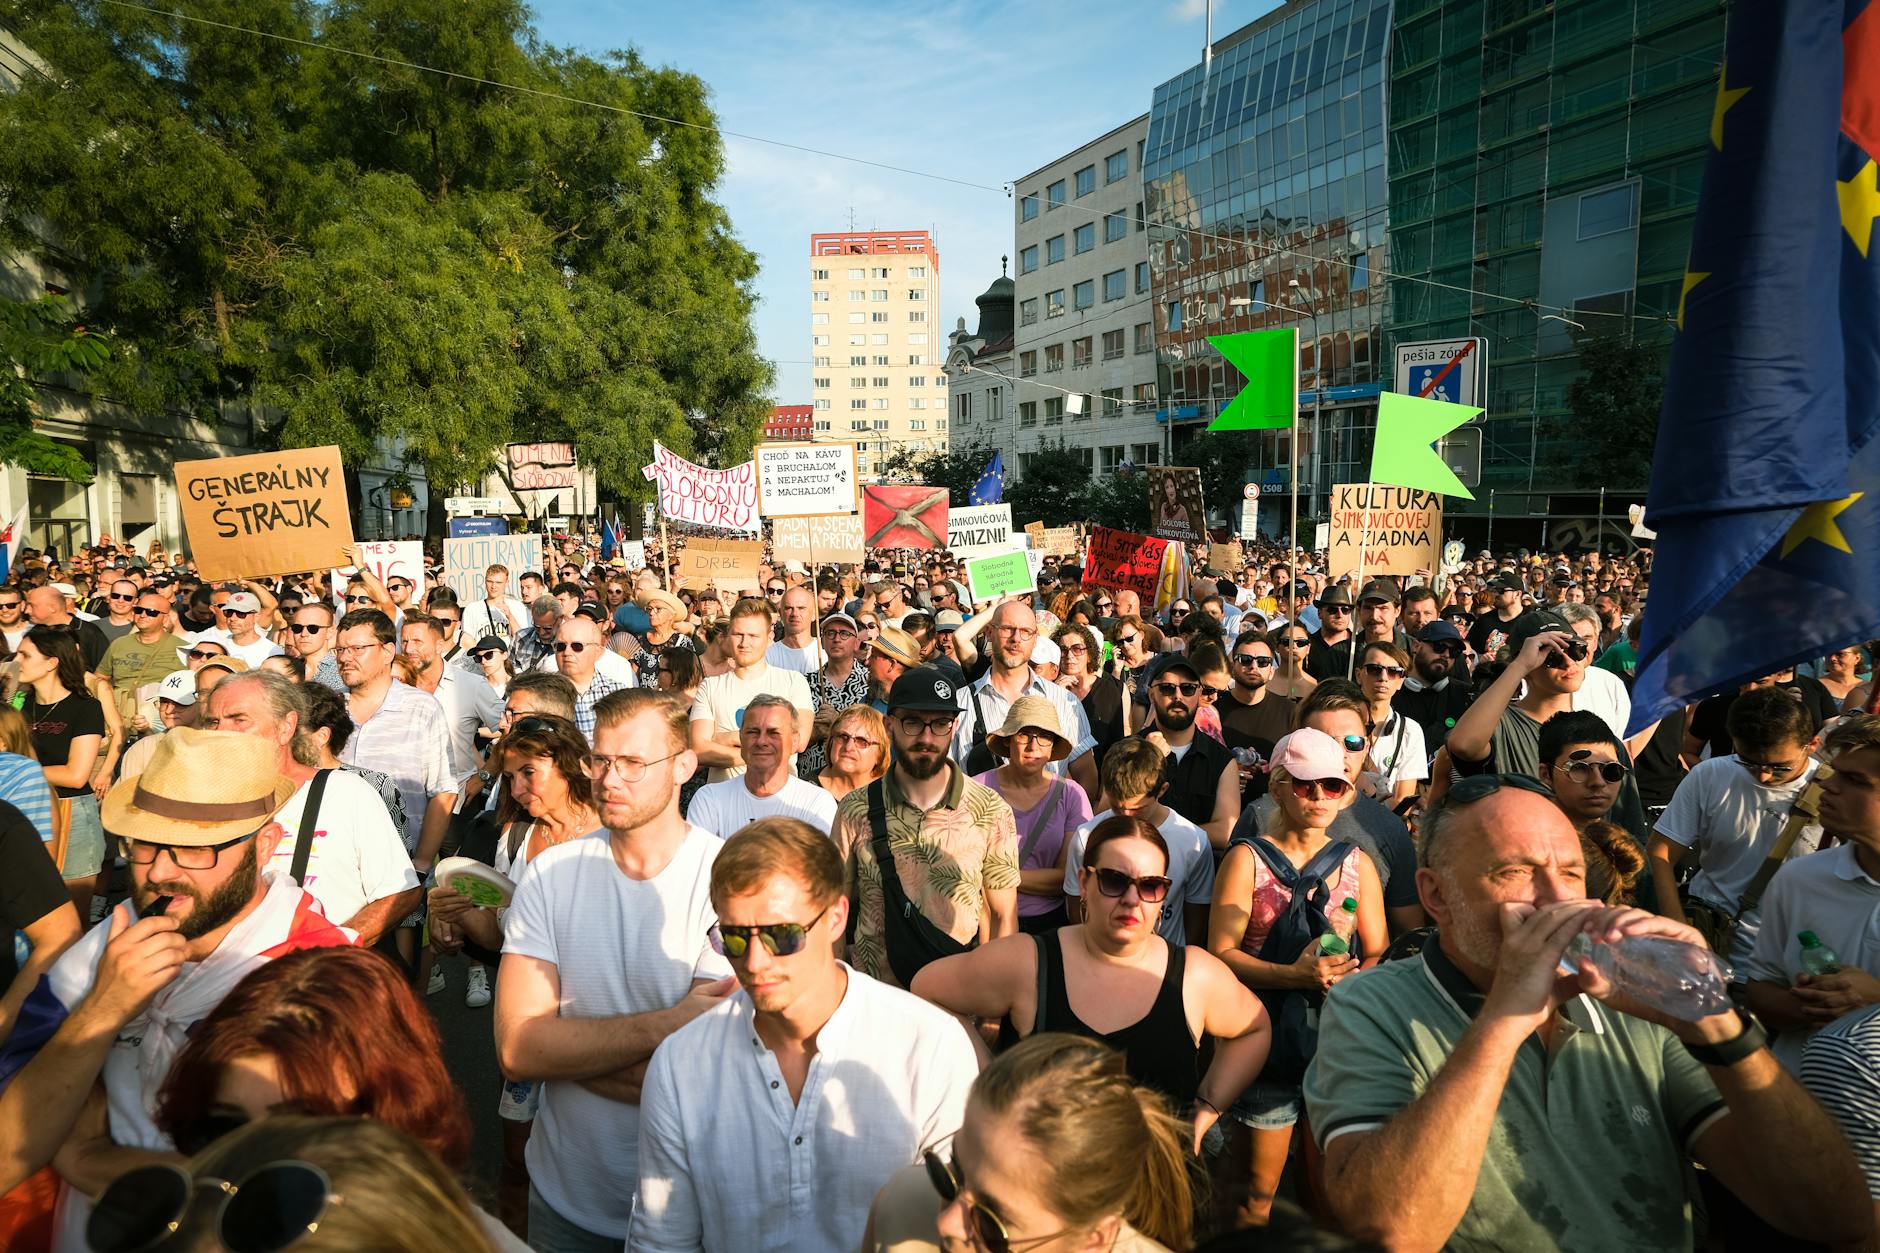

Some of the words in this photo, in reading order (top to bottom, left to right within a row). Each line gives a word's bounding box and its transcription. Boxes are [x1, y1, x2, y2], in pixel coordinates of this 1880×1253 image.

[1403, 349, 1435, 364] pešia
[1440, 347, 1469, 359] zóna
[763, 450, 789, 461] CHOĎ
[795, 451, 809, 460] NA
[815, 448, 842, 459] KÁVU
[644, 464, 663, 478] ZA
[764, 465, 771, 473] S
[776, 462, 837, 473] BRUCHALOM
[188, 463, 330, 501] GENERÁLNY
[764, 477, 772, 485] A
[777, 474, 830, 484] NEPAKTUJ
[662, 471, 757, 508] SLOBODNÚ
[765, 489, 772, 497] S
[778, 486, 836, 497] MACHALOM!
[213, 498, 330, 538] ŠTRAJK
[1162, 520, 1190, 528] DOLORES
[1333, 510, 1431, 529] ŠIMKOVIČOVEJ
[948, 527, 1006, 548] ZMIZNI!
[1156, 527, 1199, 540] ŠIMKOVIČOVÁ
[1336, 530, 1351, 546] A
[388, 544, 396, 553] S
[1091, 527, 1113, 549] MY
[1114, 538, 1140, 554] sme
[1142, 542, 1161, 560] vás
[695, 555, 740, 568] DRBE
[1364, 548, 1390, 566] NÁ
[981, 559, 1014, 571] Slobodná
[986, 569, 1014, 581] národná
[1088, 560, 1104, 579] VY
[1102, 567, 1125, 585] ste
[1128, 573, 1154, 590] nás
[472, 573, 487, 601] IB
[990, 579, 1014, 590] galéria
